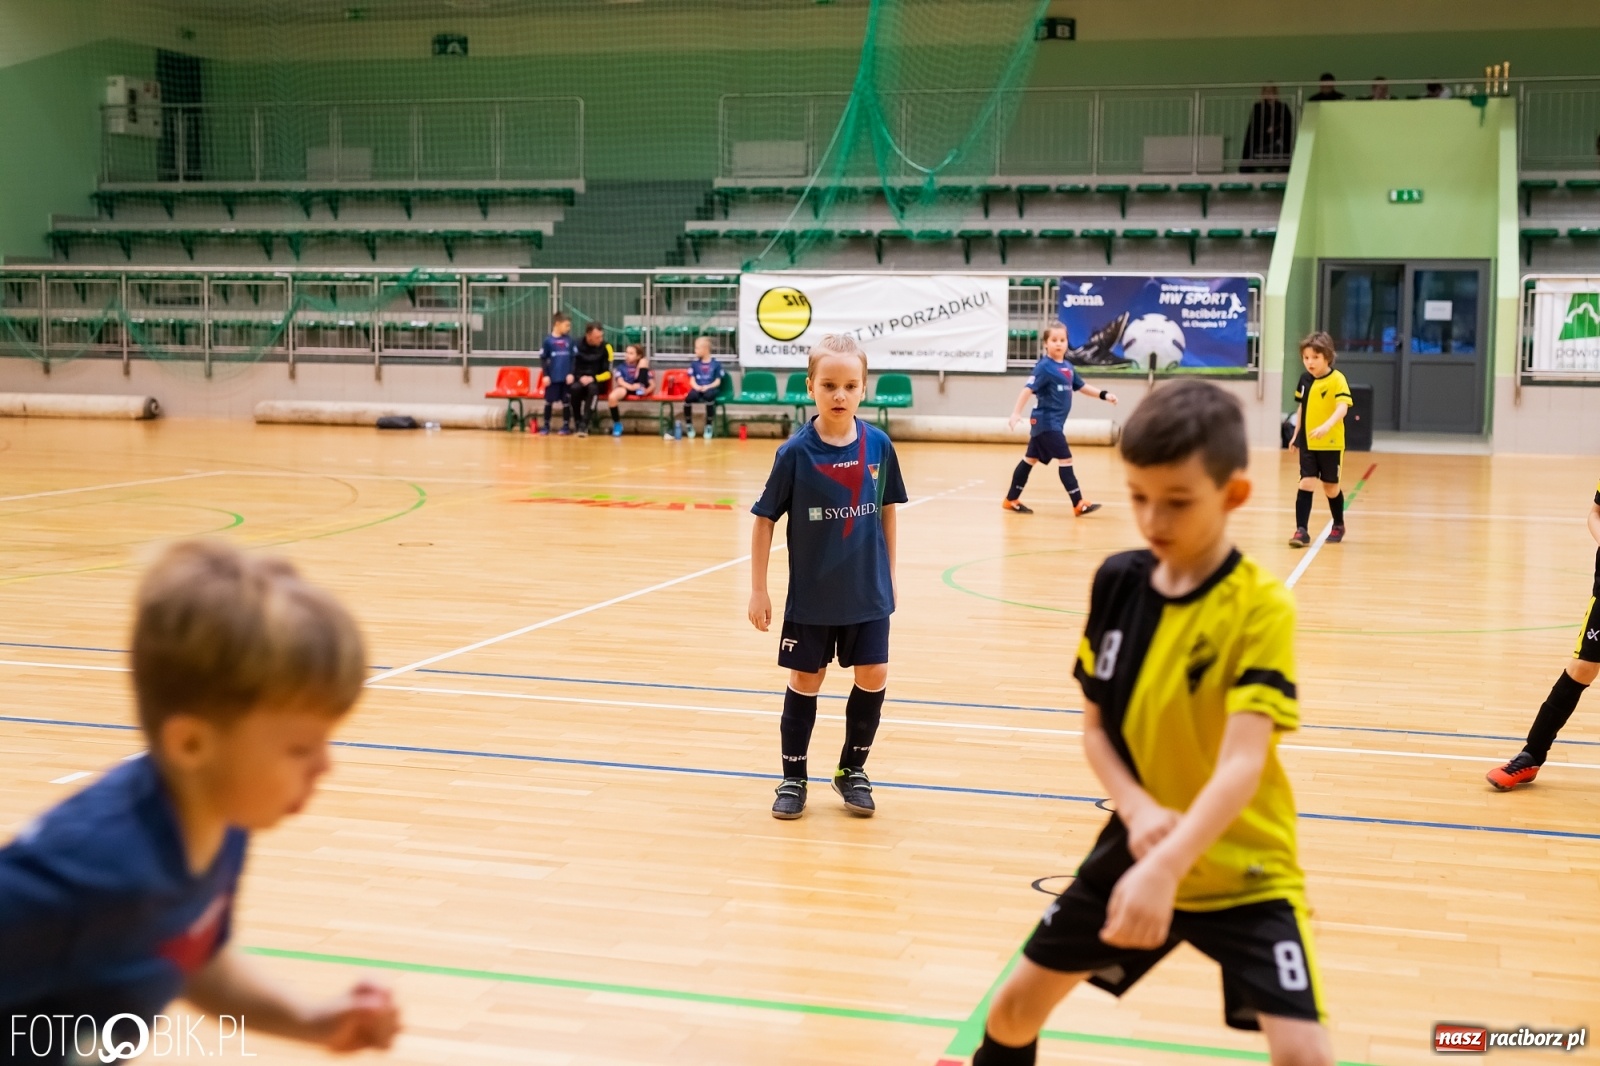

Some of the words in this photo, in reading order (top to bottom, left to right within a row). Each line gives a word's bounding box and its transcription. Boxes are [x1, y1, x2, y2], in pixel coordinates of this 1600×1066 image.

[1159, 292, 1184, 305] MW
[1184, 292, 1228, 305] SPORT
[833, 460, 859, 469] regio
[1095, 629, 1123, 681] 8
[1273, 940, 1308, 991] 8
